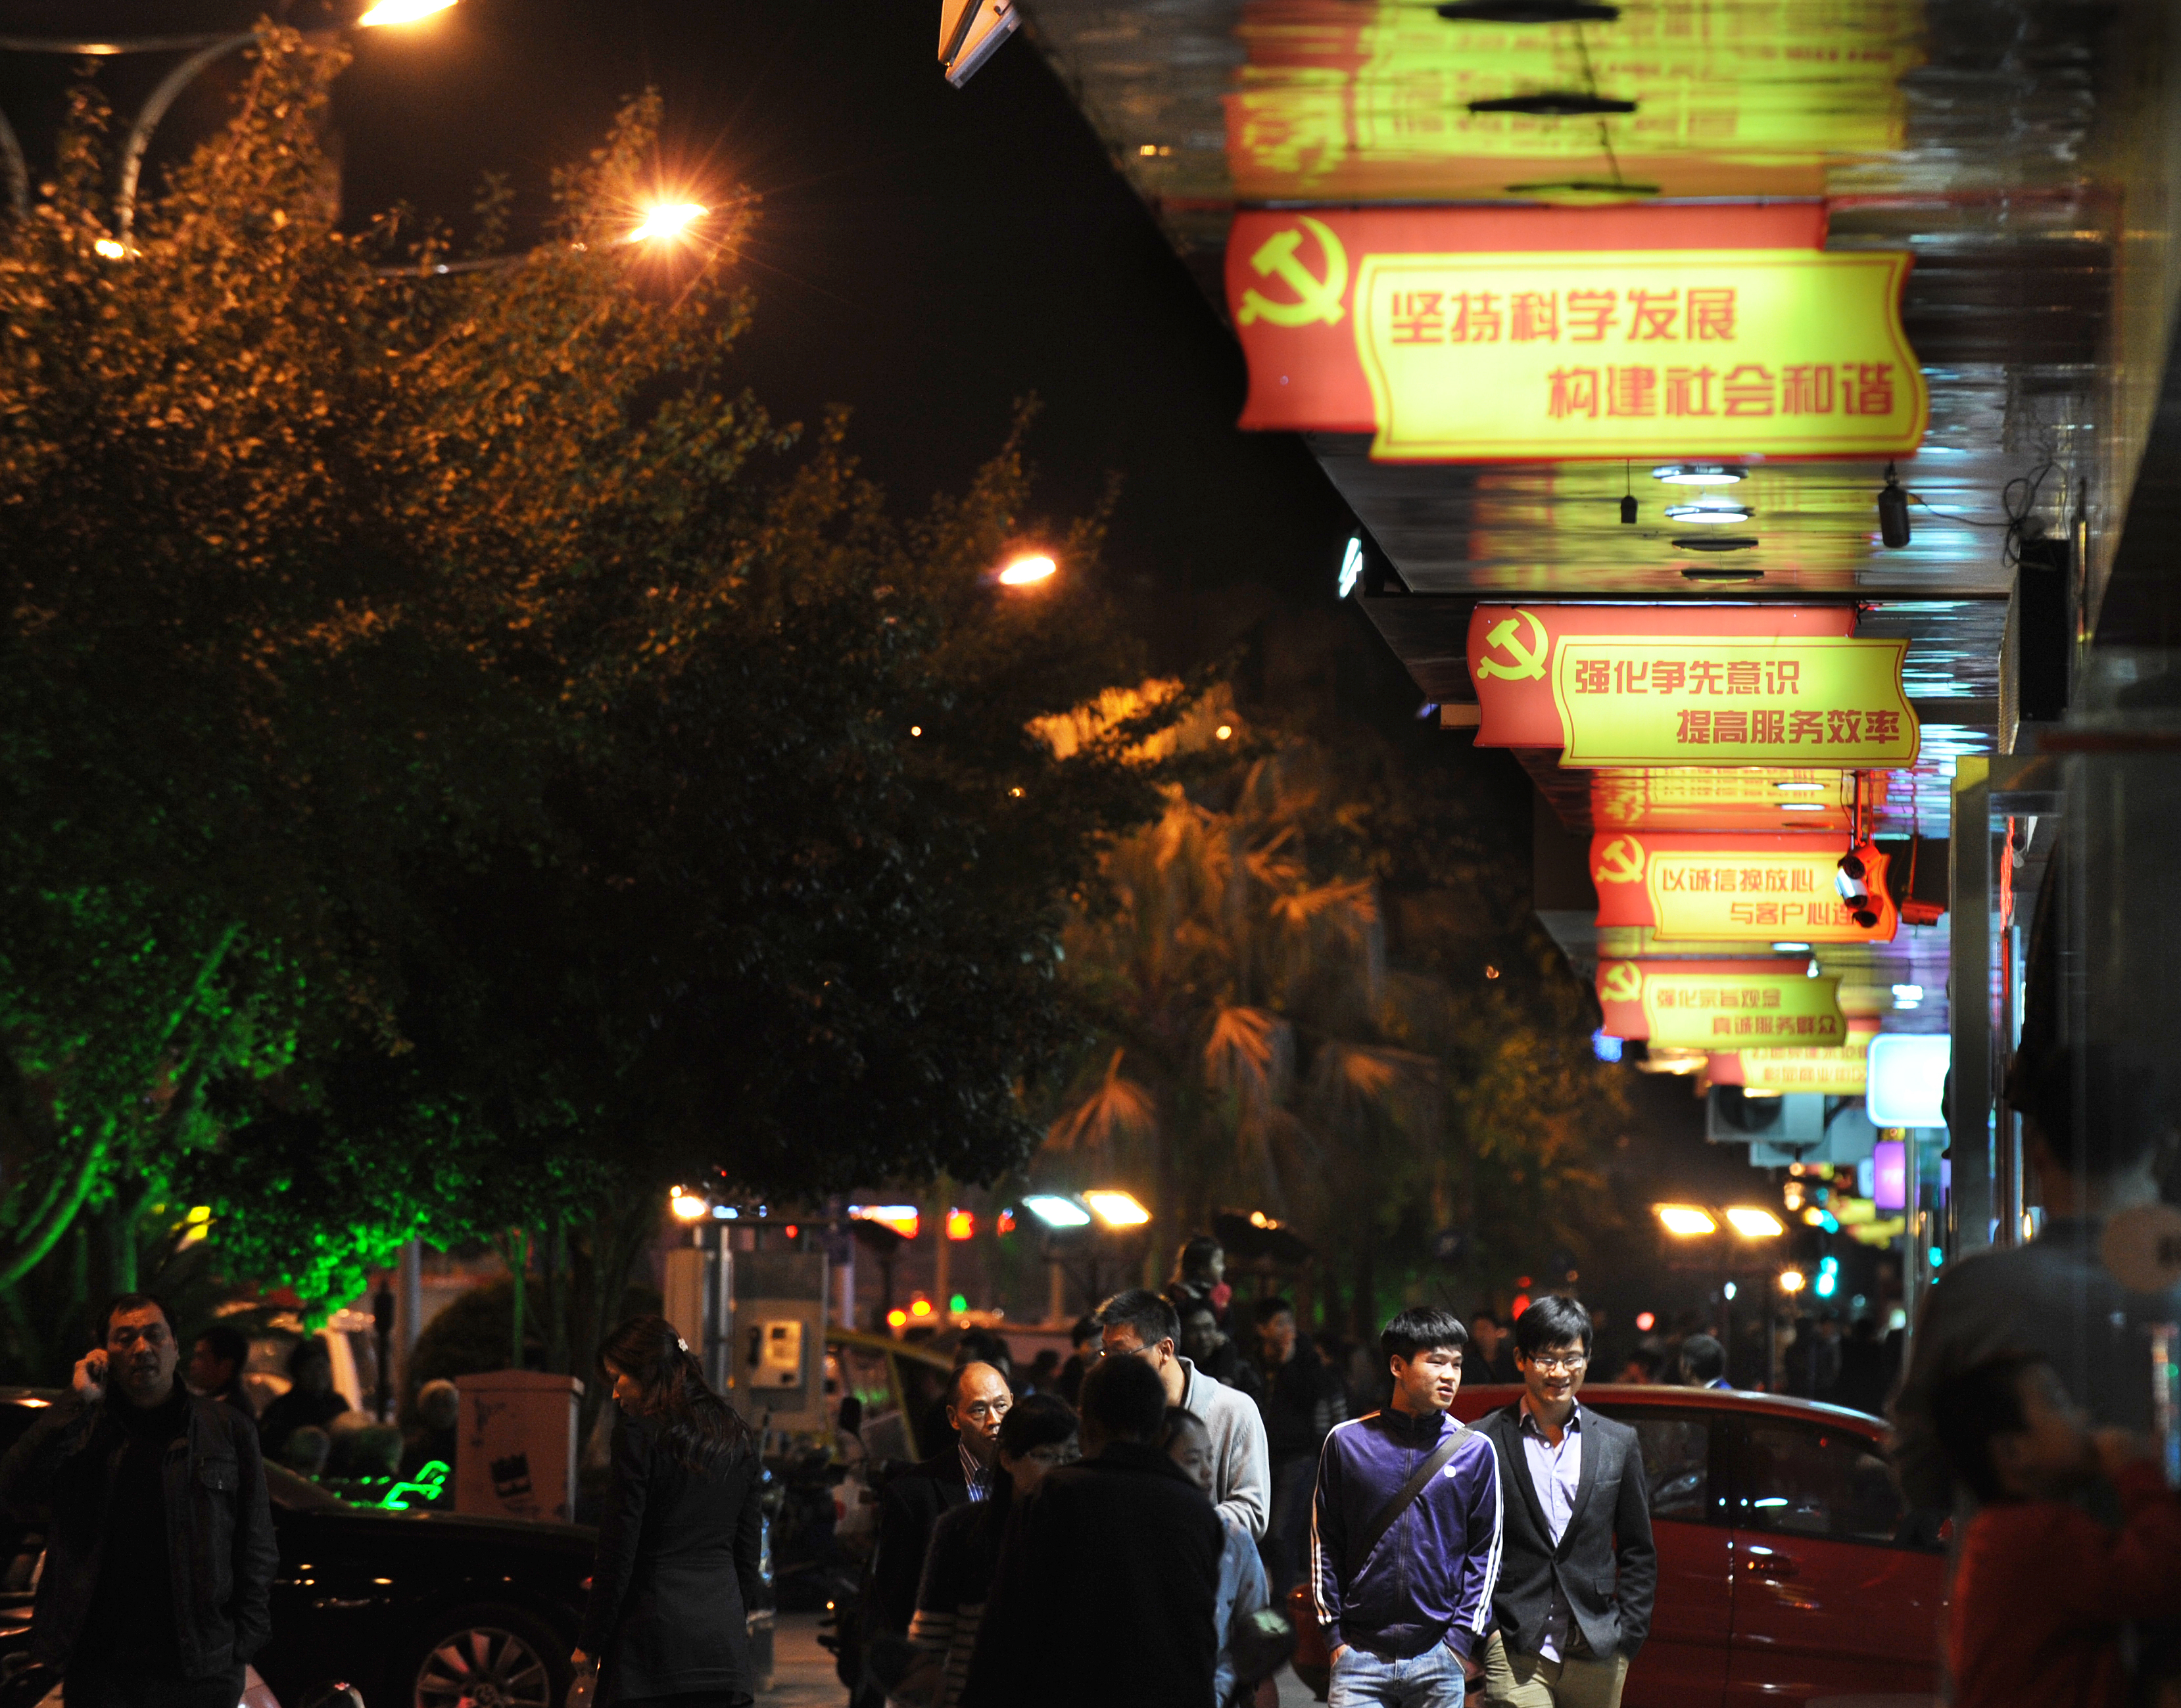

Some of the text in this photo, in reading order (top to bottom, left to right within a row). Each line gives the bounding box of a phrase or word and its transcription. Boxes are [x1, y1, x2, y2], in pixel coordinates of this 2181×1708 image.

[1391, 289, 1737, 344] 坚持科学发展
[1547, 363, 1895, 419] 构建社会和谐
[1575, 660, 1800, 694] 强化争先意识
[1677, 710, 1900, 744] 提高服务效率
[1663, 868, 1814, 892] 以诚信换放心
[1731, 902, 1879, 926] 与客户心连
